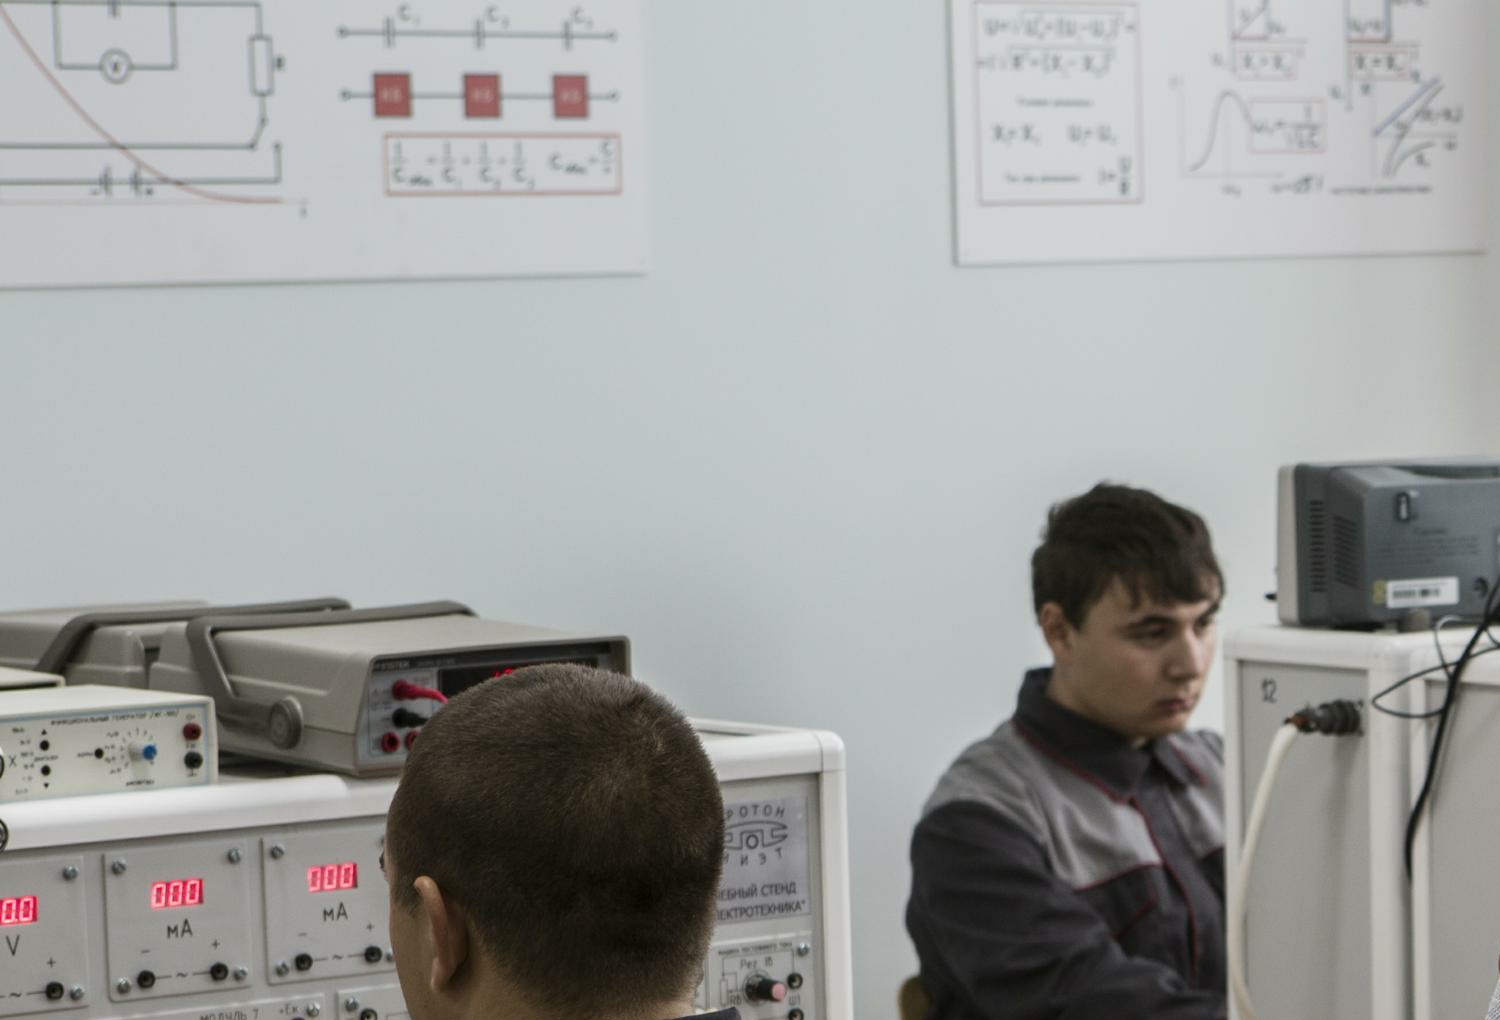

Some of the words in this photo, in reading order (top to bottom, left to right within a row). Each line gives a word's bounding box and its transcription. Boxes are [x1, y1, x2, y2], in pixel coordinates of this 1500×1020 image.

[1262, 677, 1277, 704] 12
[307, 863, 356, 893] 000
[151, 879, 203, 909] 000
[717, 884, 758, 901] ЕБНЫЙ
[761, 882, 797, 897] СТЕНД
[6, 935, 20, 957] V
[253, 1008, 260, 1020] 7
